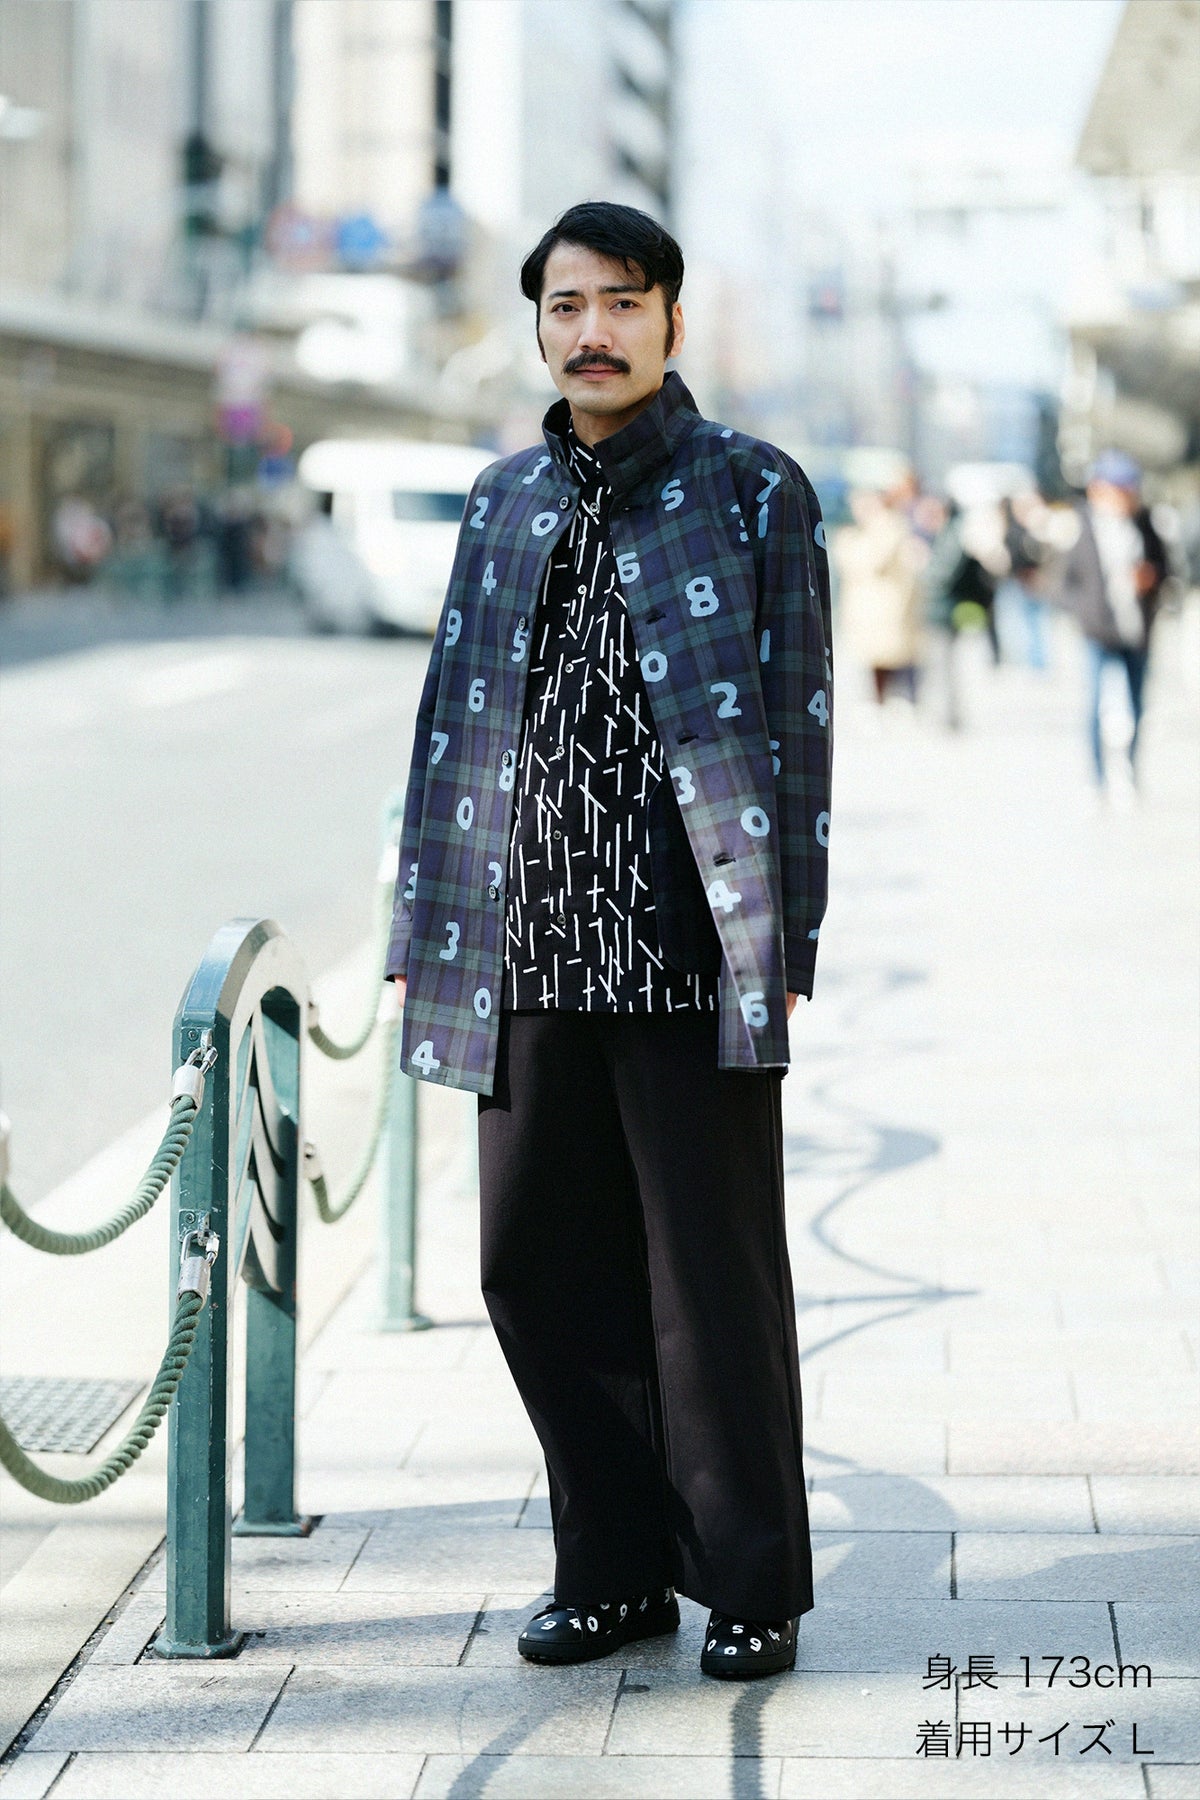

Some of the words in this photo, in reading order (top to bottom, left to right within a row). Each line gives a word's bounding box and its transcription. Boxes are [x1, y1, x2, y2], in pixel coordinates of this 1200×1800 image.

[755, 468, 781, 503] 7
[469, 496, 490, 530] 2
[531, 511, 559, 537] 0
[481, 560, 497, 596] 4
[616, 551, 641, 584] 6
[685, 575, 719, 618] 8
[444, 608, 463, 647] 9
[511, 627, 529, 663] 5
[640, 650, 668, 683] 0
[468, 678, 486, 713] 6
[710, 681, 742, 719] 2
[807, 689, 830, 728] 4
[430, 731, 450, 765] 7
[498, 748, 517, 793] 8
[670, 766, 697, 806] 3
[456, 796, 475, 831] 0
[740, 806, 770, 837] 0
[707, 880, 742, 914] 4
[438, 921, 461, 961] 3
[473, 987, 492, 1020] 0
[740, 991, 769, 1028] 6
[411, 1040, 441, 1076] 4
